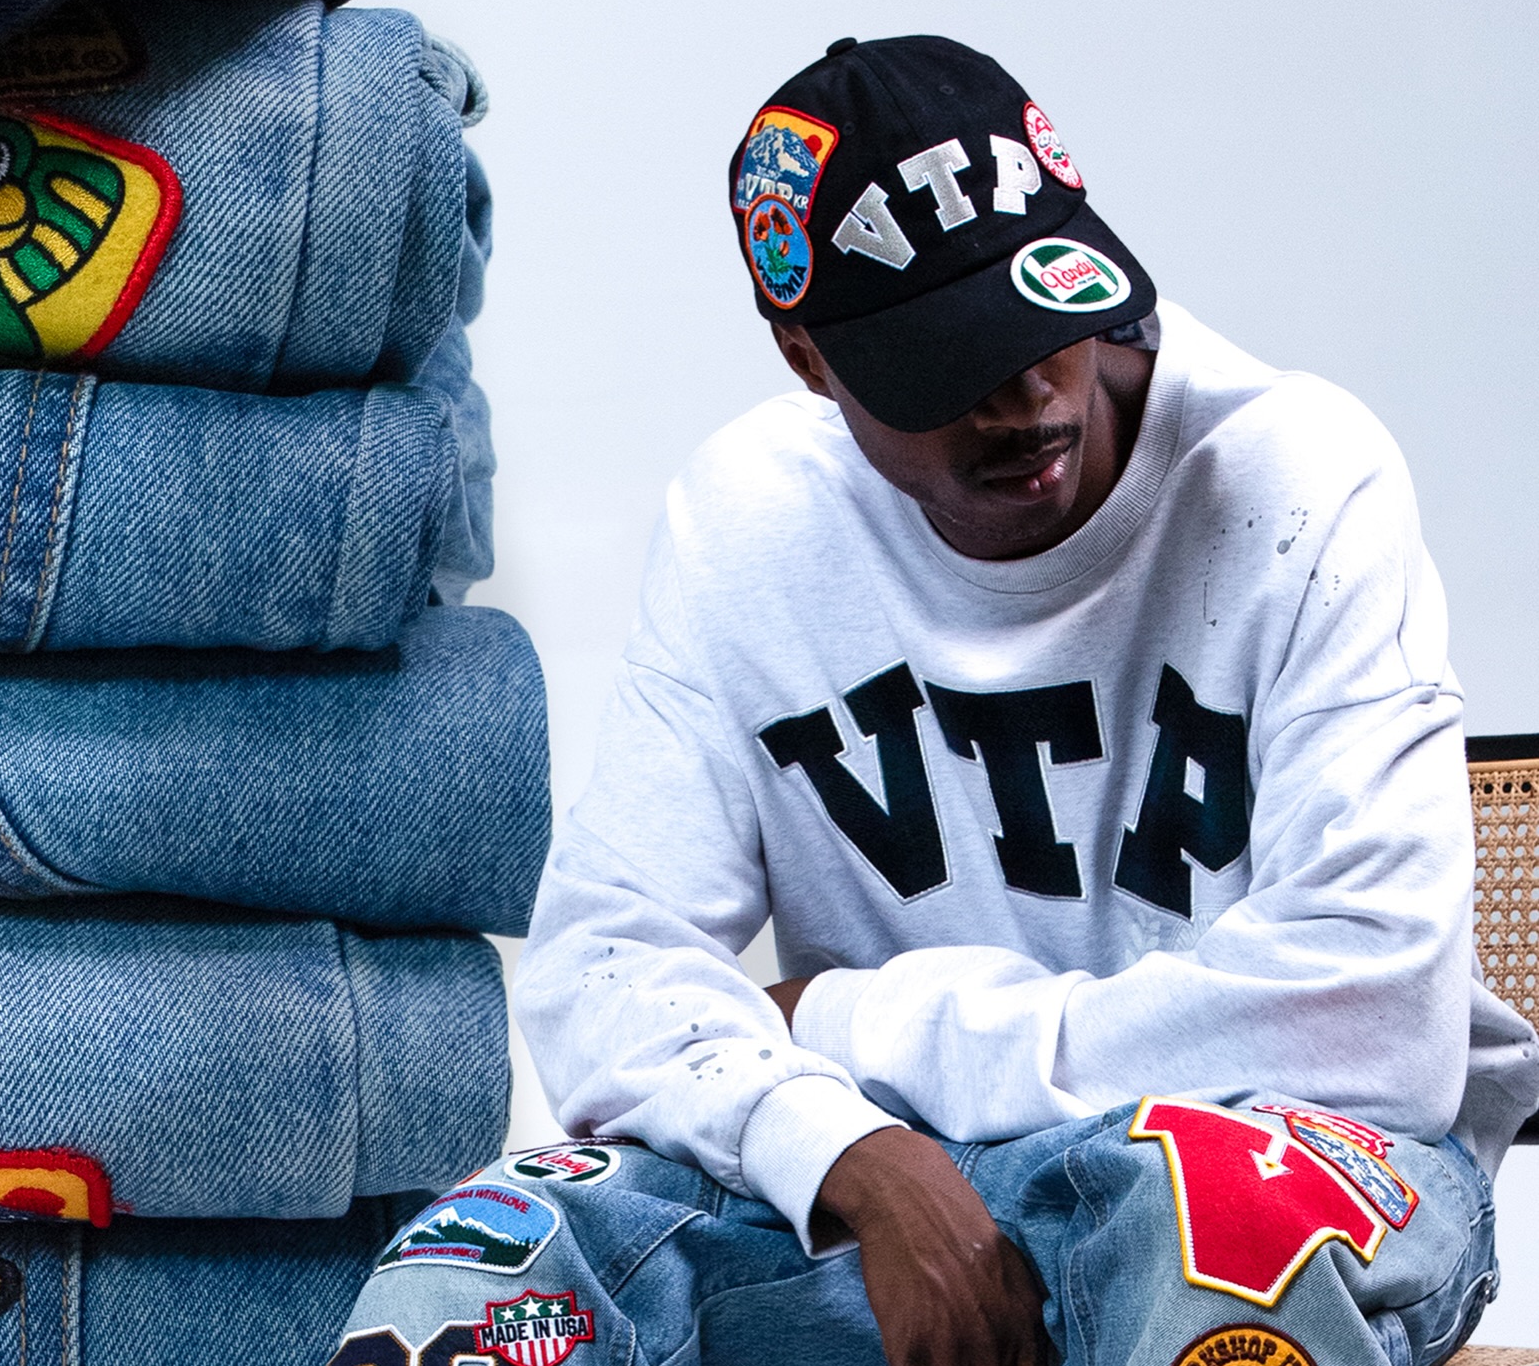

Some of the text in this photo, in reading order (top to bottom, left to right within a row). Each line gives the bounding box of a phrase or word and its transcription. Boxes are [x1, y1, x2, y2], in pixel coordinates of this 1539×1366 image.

[831, 134, 1043, 271] VTP
[1040, 259, 1102, 291] Vandy
[756, 656, 1252, 922] VTP
[499, 1192, 532, 1215] LOVE
[481, 1316, 588, 1348] MADE IN USA
